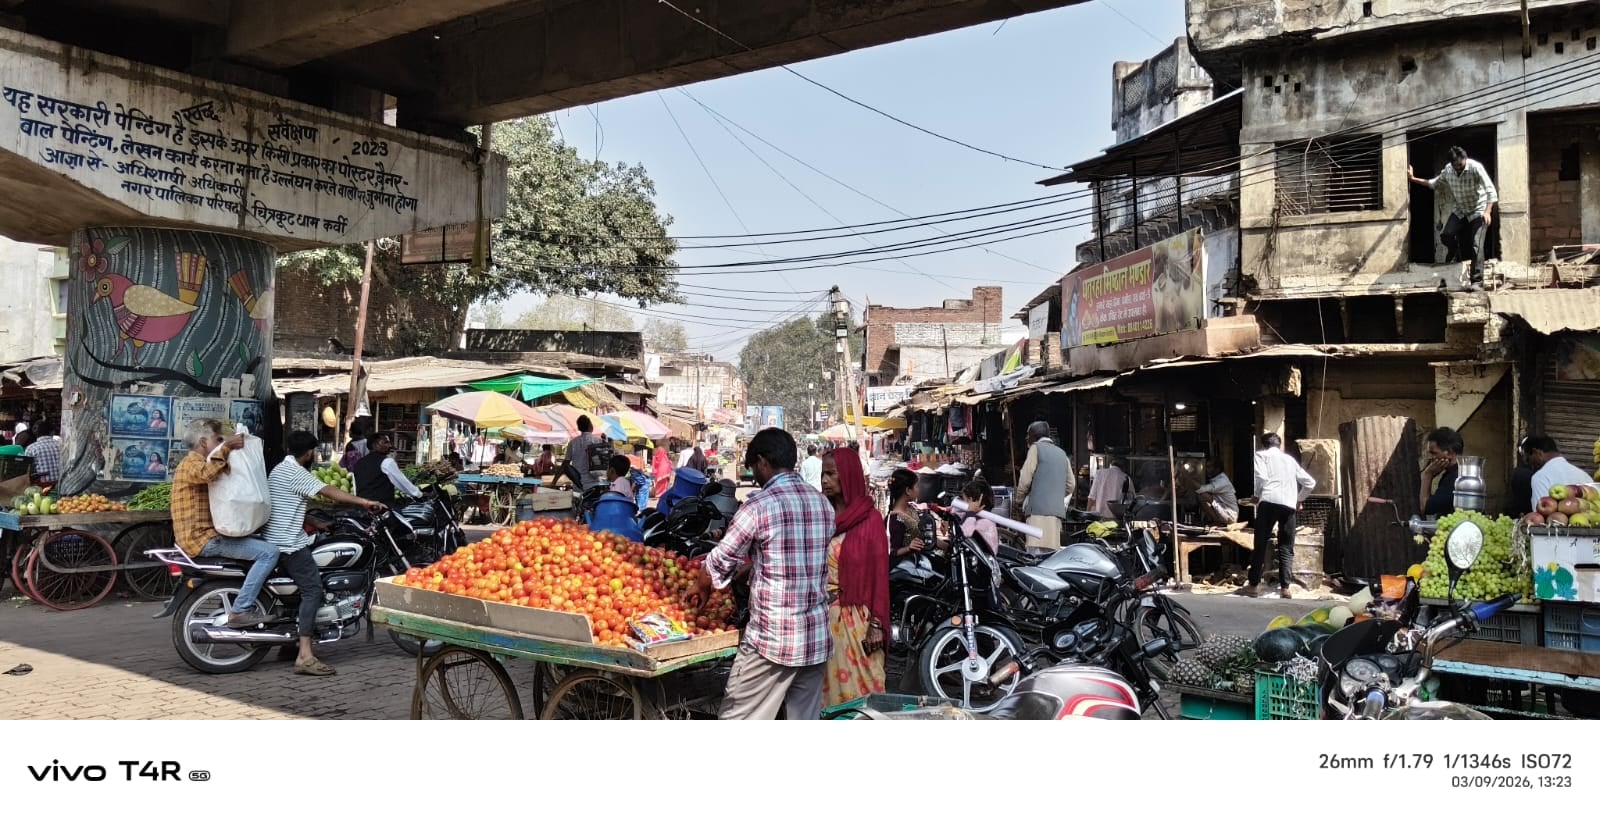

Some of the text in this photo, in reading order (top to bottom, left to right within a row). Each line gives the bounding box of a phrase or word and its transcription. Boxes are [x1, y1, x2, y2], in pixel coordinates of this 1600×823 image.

[3, 86, 34, 113] यह
[37, 95, 111, 128] सरकारी
[114, 103, 171, 138] पेन्टिंग
[172, 111, 186, 145] है
[188, 129, 228, 151] इसके
[262, 141, 290, 166] किसी
[291, 152, 320, 176] प्रकार
[321, 159, 338, 174] का
[267, 114, 318, 144] सर्वेक्षण
[351, 141, 388, 156] 2023
[120, 134, 163, 160] लेखन
[165, 149, 199, 167] कार्य
[200, 155, 235, 176] करना
[236, 162, 261, 180] मना
[261, 164, 271, 185] है
[271, 171, 313, 191] उल्लंघन
[314, 176, 338, 196] करने
[395, 191, 418, 214] होगा
[190, 173, 245, 199] अधिकारी
[121, 180, 154, 200] नगर
[155, 185, 204, 206] पालिका
[252, 200, 296, 234] चित्रकूट
[296, 214, 320, 229] धाम
[323, 215, 349, 233] कर्वी
